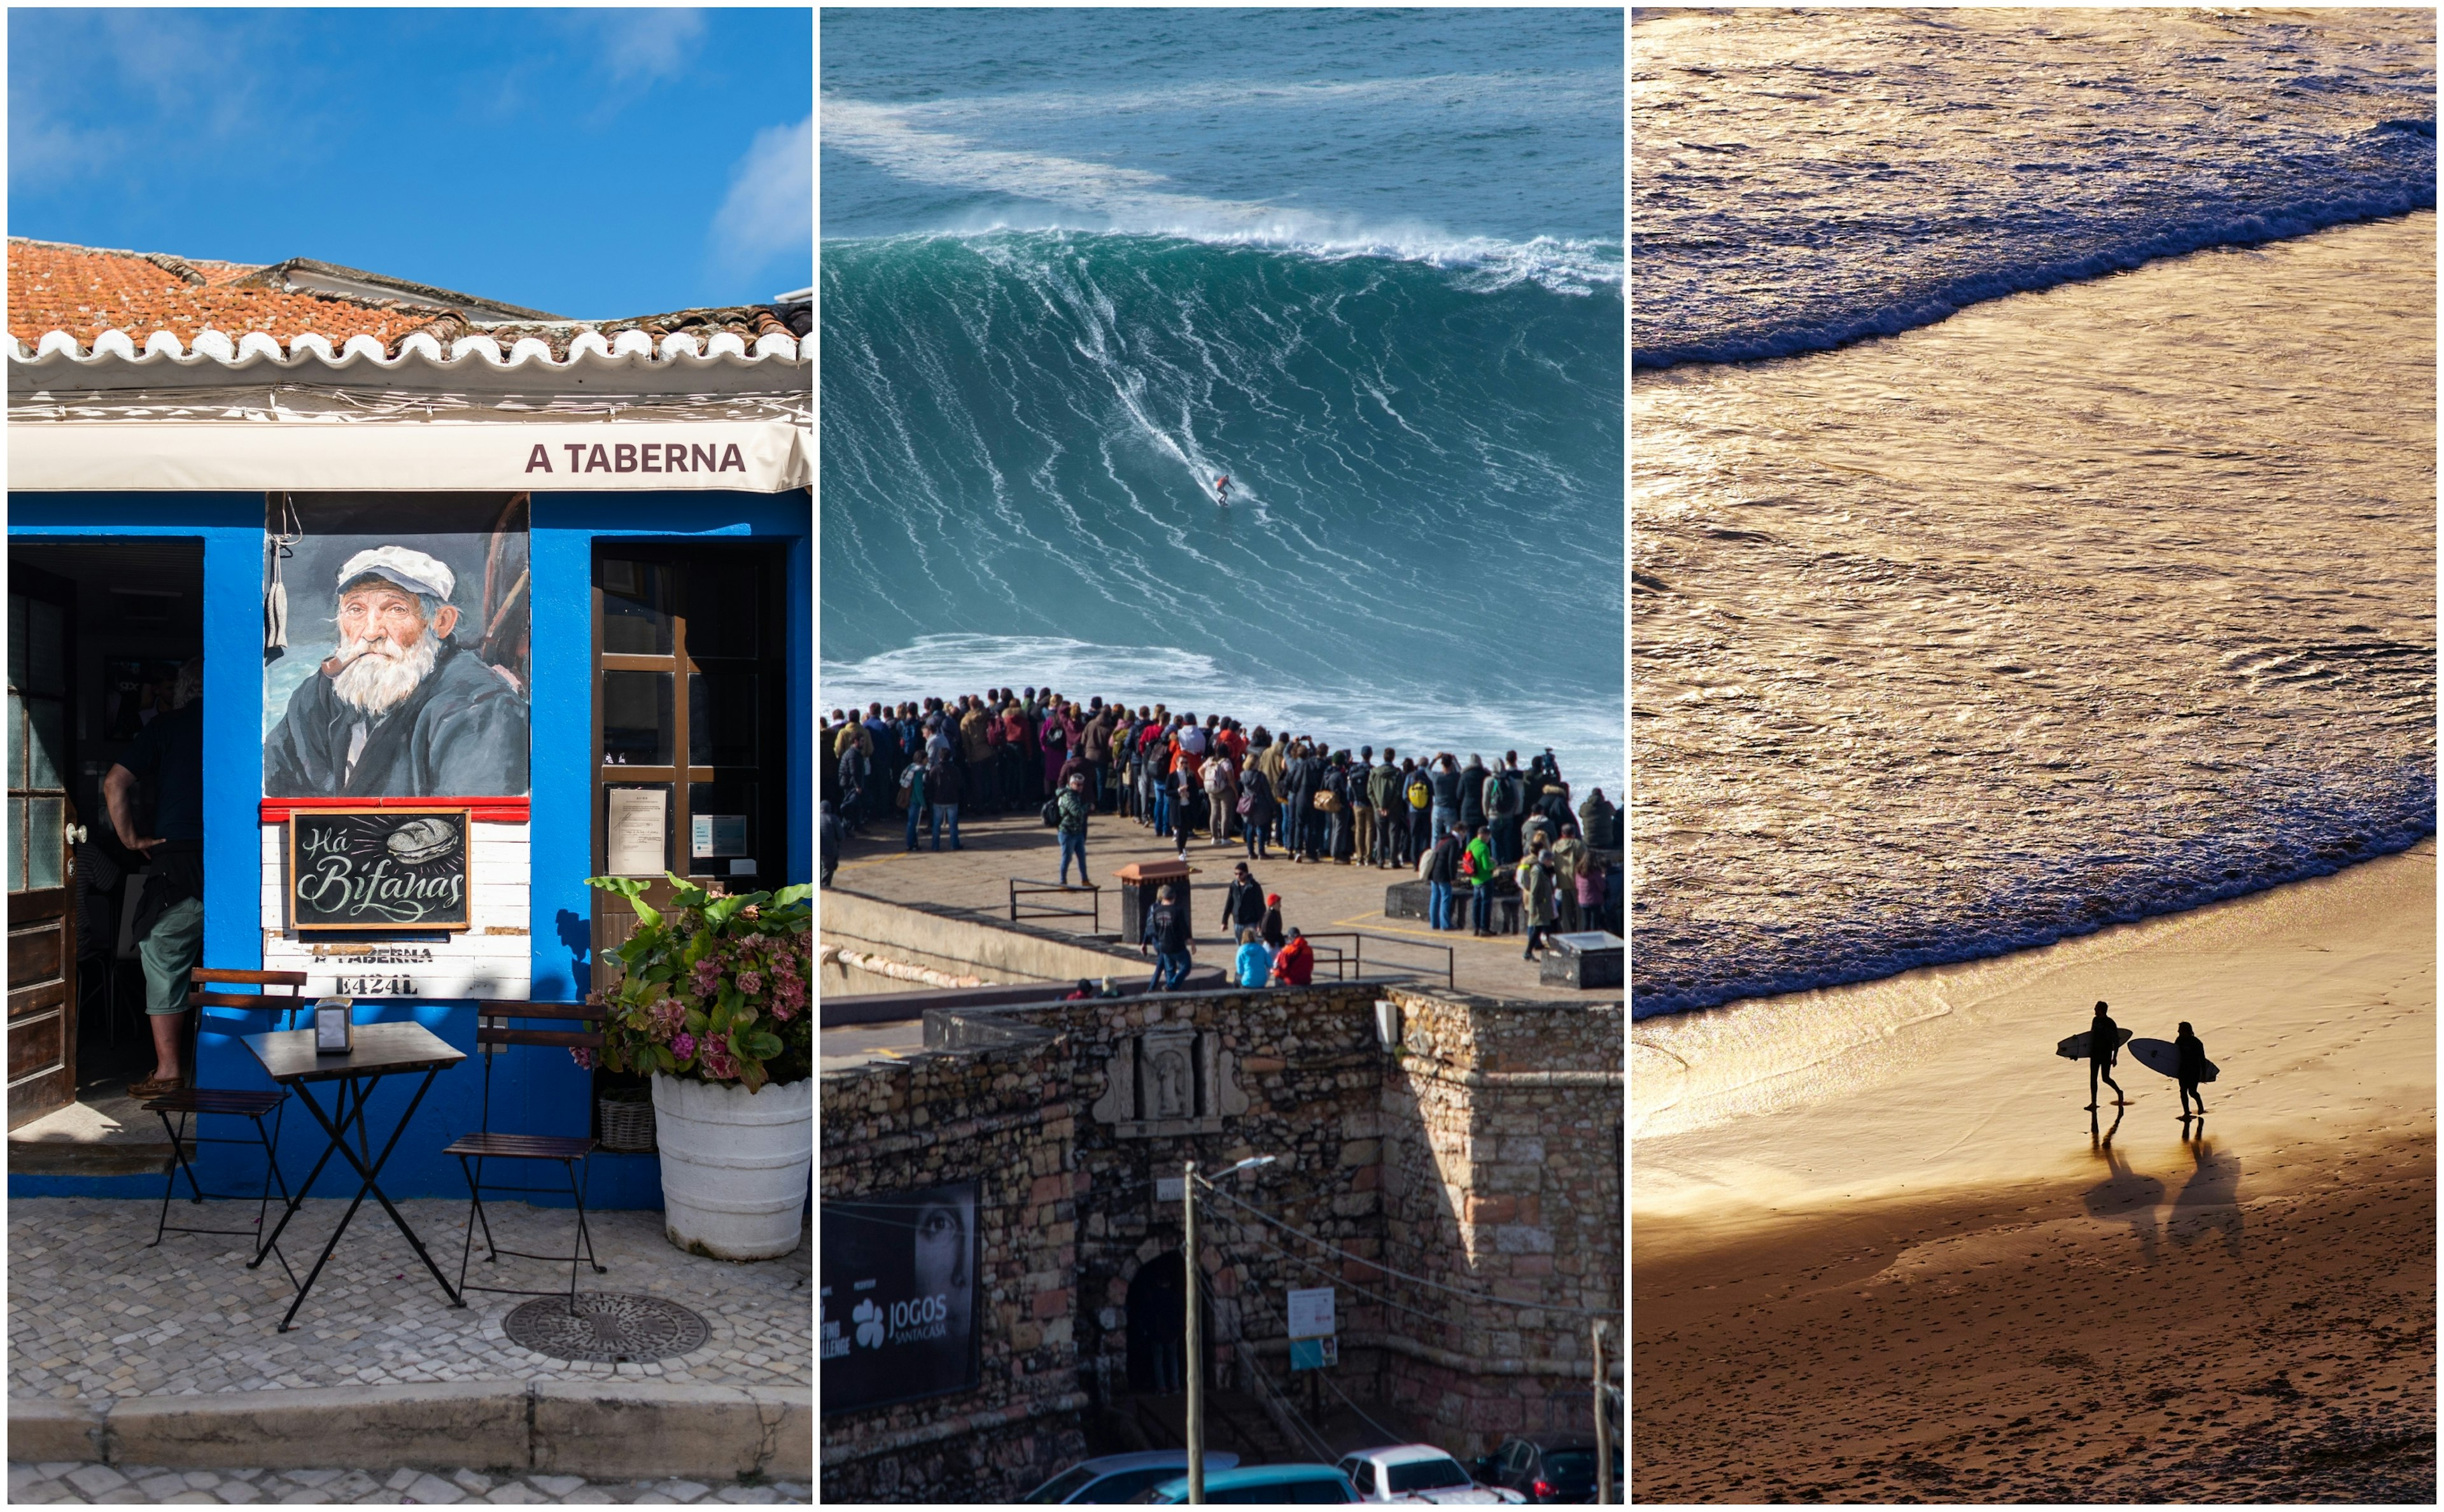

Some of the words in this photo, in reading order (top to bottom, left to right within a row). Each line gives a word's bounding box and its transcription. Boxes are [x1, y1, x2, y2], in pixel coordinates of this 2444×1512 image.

[524, 444, 553, 473] A
[564, 444, 747, 473] TABERNA
[302, 828, 352, 860] Há
[297, 855, 464, 923] Bifanas
[338, 948, 433, 963] ABERNA
[888, 1293, 946, 1339] JOGOS
[820, 1336, 850, 1359] LLENGE
